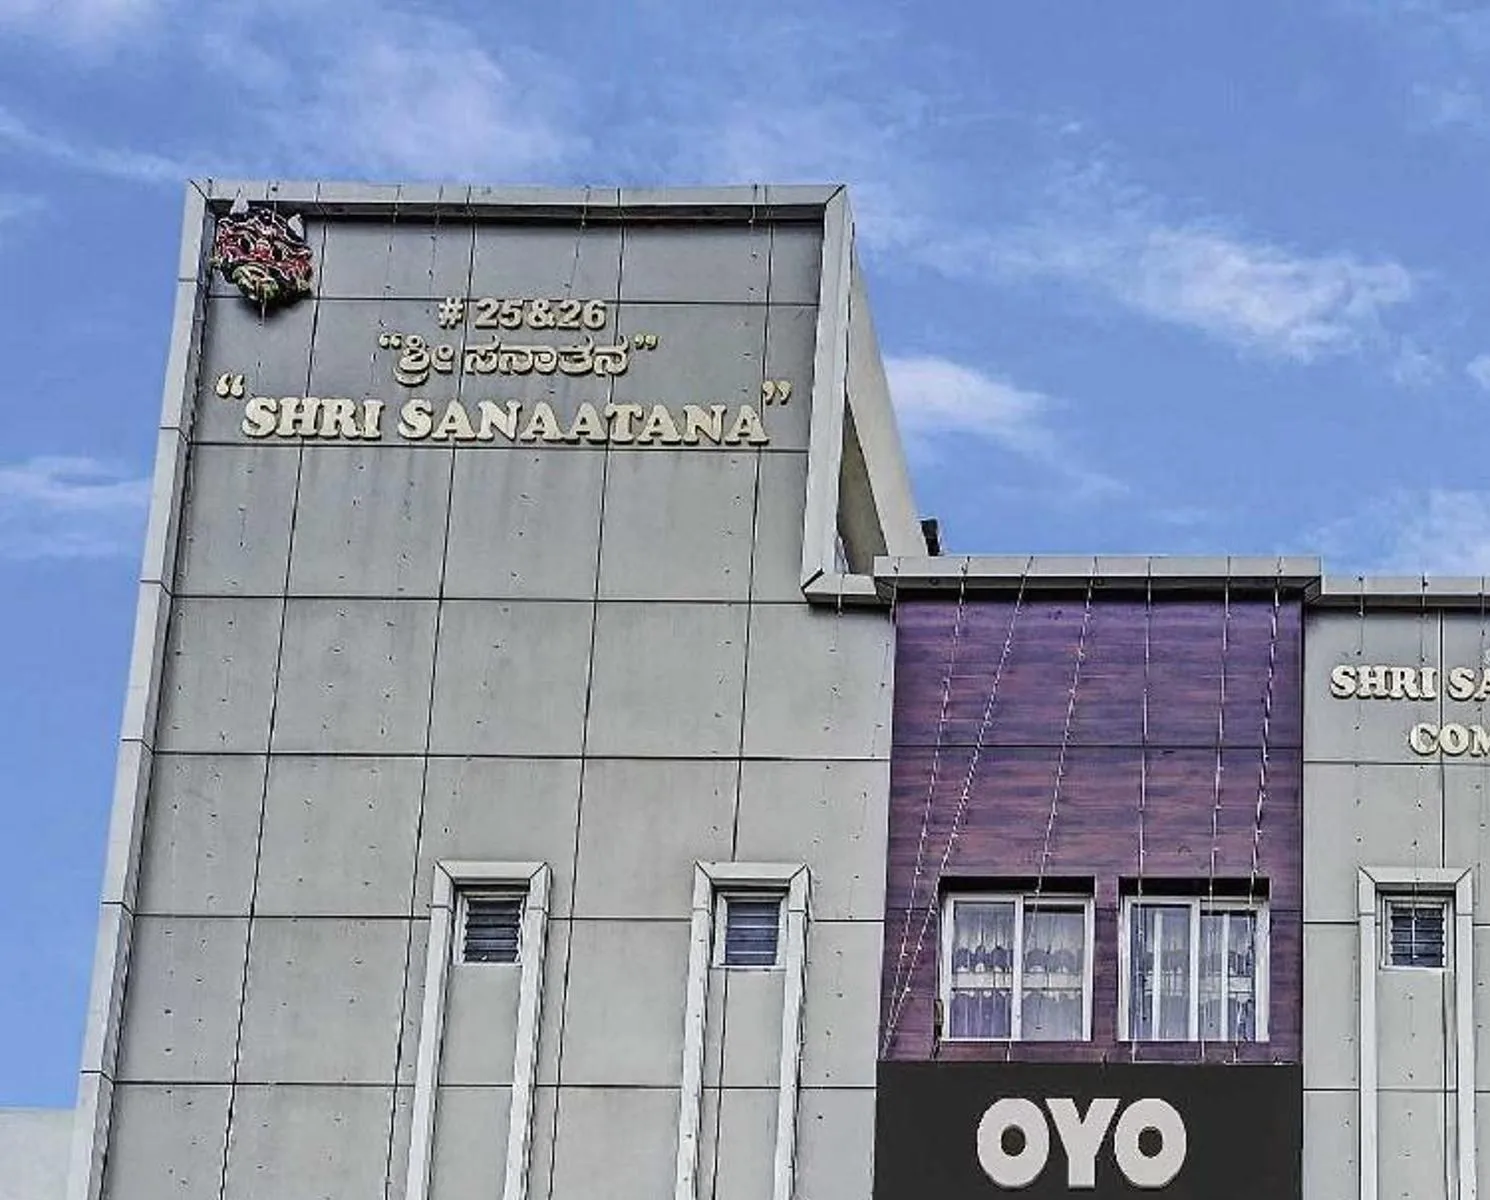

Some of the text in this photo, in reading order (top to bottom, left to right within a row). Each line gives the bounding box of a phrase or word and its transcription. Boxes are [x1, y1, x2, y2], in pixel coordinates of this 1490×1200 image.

[439, 297, 607, 331] # 25&26
[1331, 664, 1438, 699] SHRI
[977, 1098, 1186, 1188] OYO
